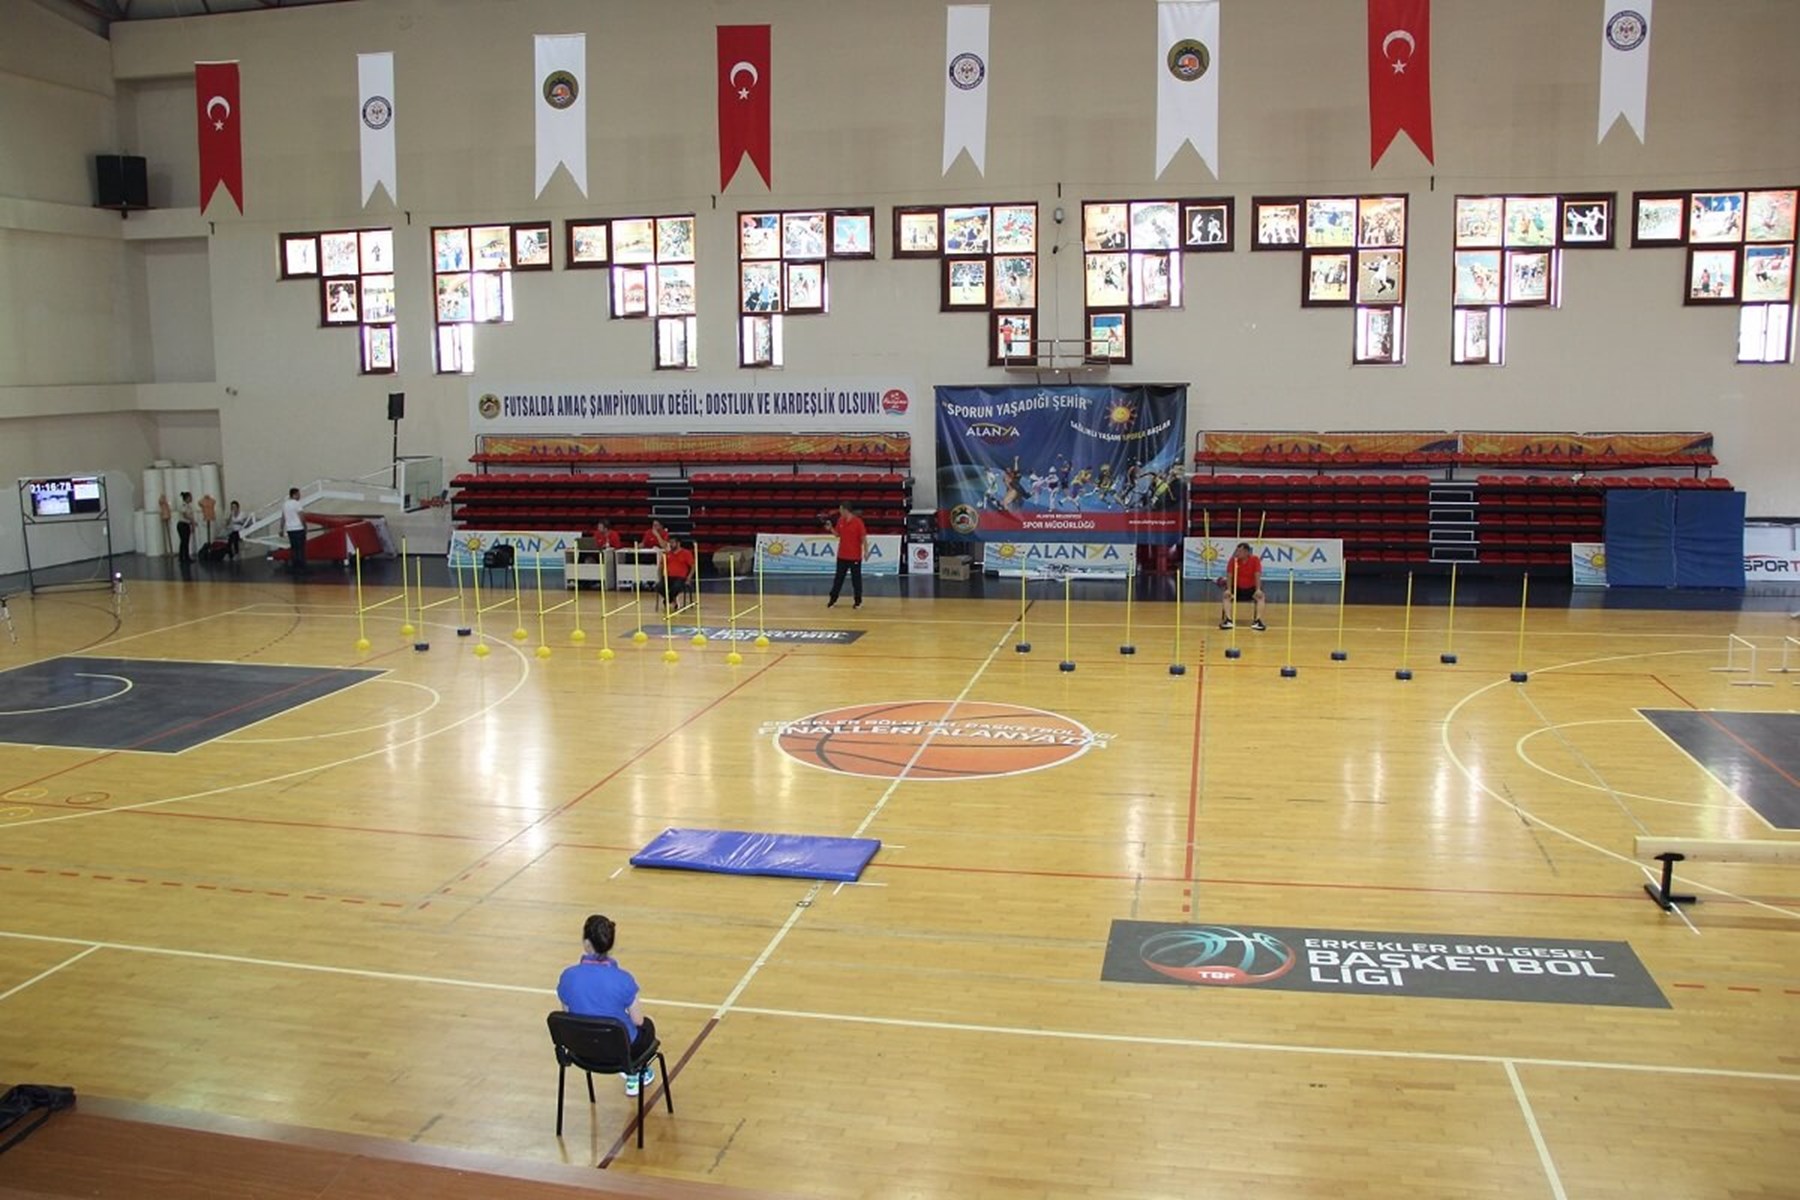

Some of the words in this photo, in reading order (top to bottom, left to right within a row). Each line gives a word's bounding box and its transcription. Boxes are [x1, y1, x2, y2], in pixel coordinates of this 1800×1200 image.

[504, 395, 554, 417] FUTSALDA
[557, 394, 586, 418] AMAÇ
[590, 390, 665, 418] ŞAMPİYONLUK
[668, 388, 703, 417] DEĞİL;
[706, 392, 754, 415] DOSTLUK
[757, 392, 770, 415] VE
[774, 388, 835, 417] KARDEŞLİK
[838, 392, 880, 415] OLSUN!
[997, 393, 1049, 417] YAŞADIĞI
[966, 424, 1020, 437] ALANYA
[794, 542, 882, 557] ALAA
[1027, 544, 1119, 559] ALANYA
[1304, 938, 1448, 954] ERKEKLER
[1455, 944, 1605, 960] BÖLGESEL
[1307, 949, 1616, 978] BASKETBOL
